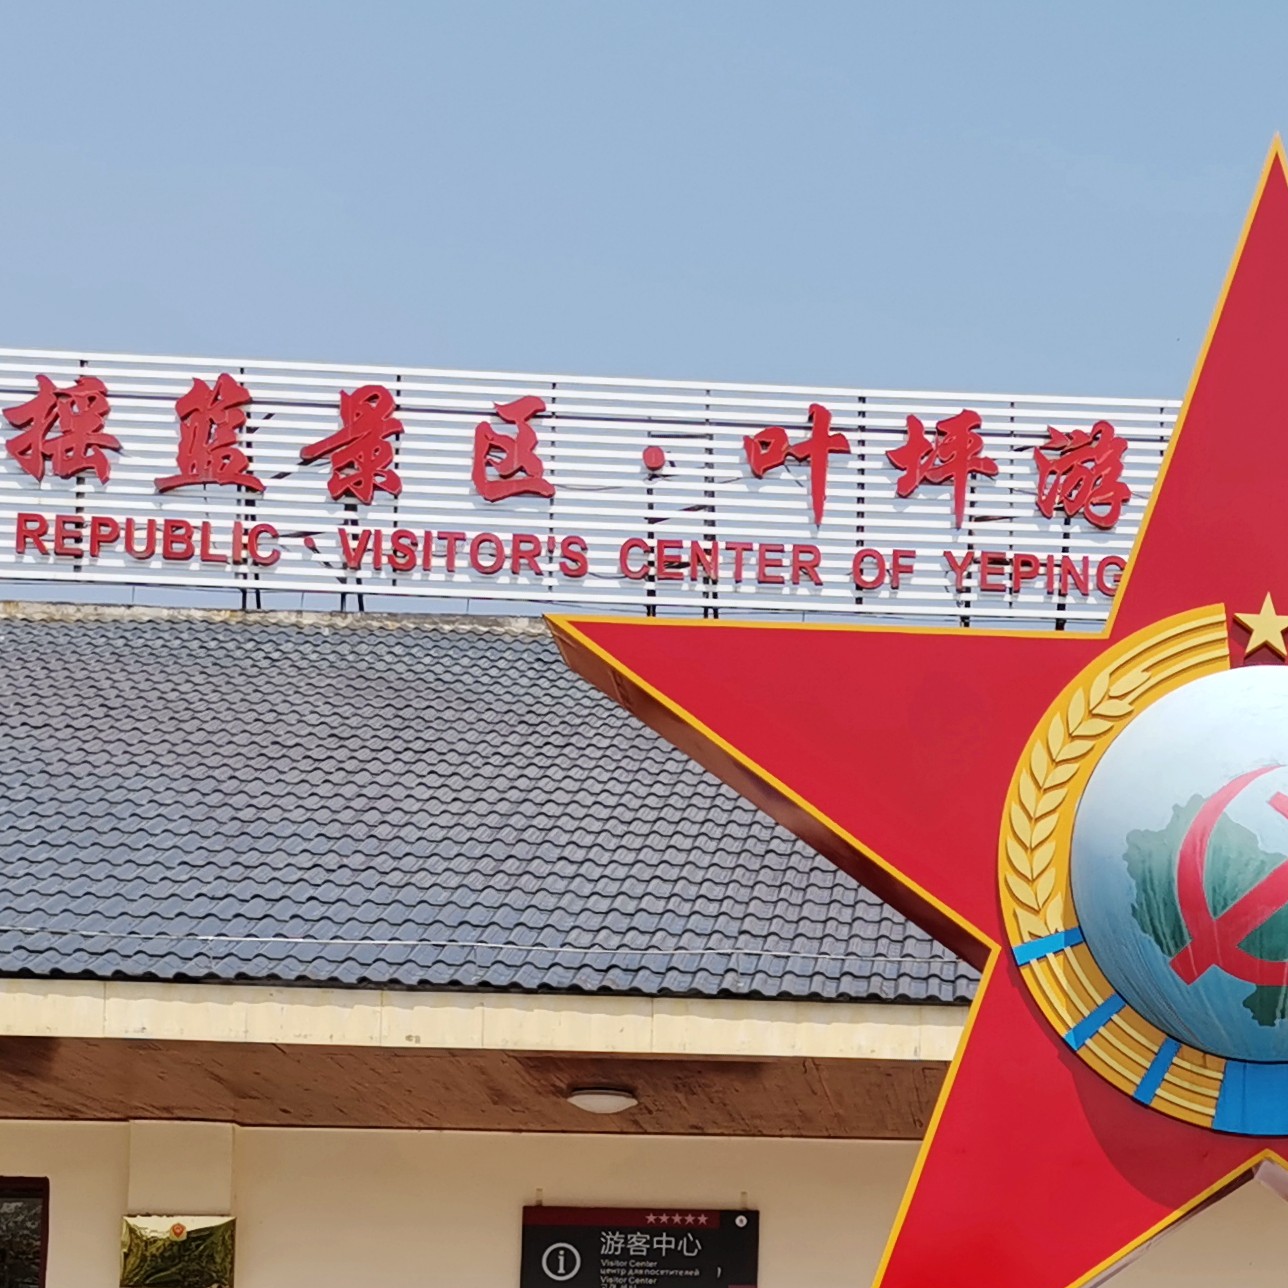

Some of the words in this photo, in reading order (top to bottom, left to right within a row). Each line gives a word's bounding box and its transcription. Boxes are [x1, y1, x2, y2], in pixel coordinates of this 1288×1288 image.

[15, 512, 282, 567] REPUBLIC
[337, 526, 589, 578] VISITOR'S
[619, 537, 823, 588] CENTER
[851, 547, 918, 591] OF
[943, 550, 1127, 598] YEPING
[600, 1231, 702, 1257] 游客中心
[600, 1259, 628, 1268] Visitor
[629, 1259, 658, 1268] Center
[600, 1276, 628, 1285] Visitor
[629, 1276, 657, 1285] Center
